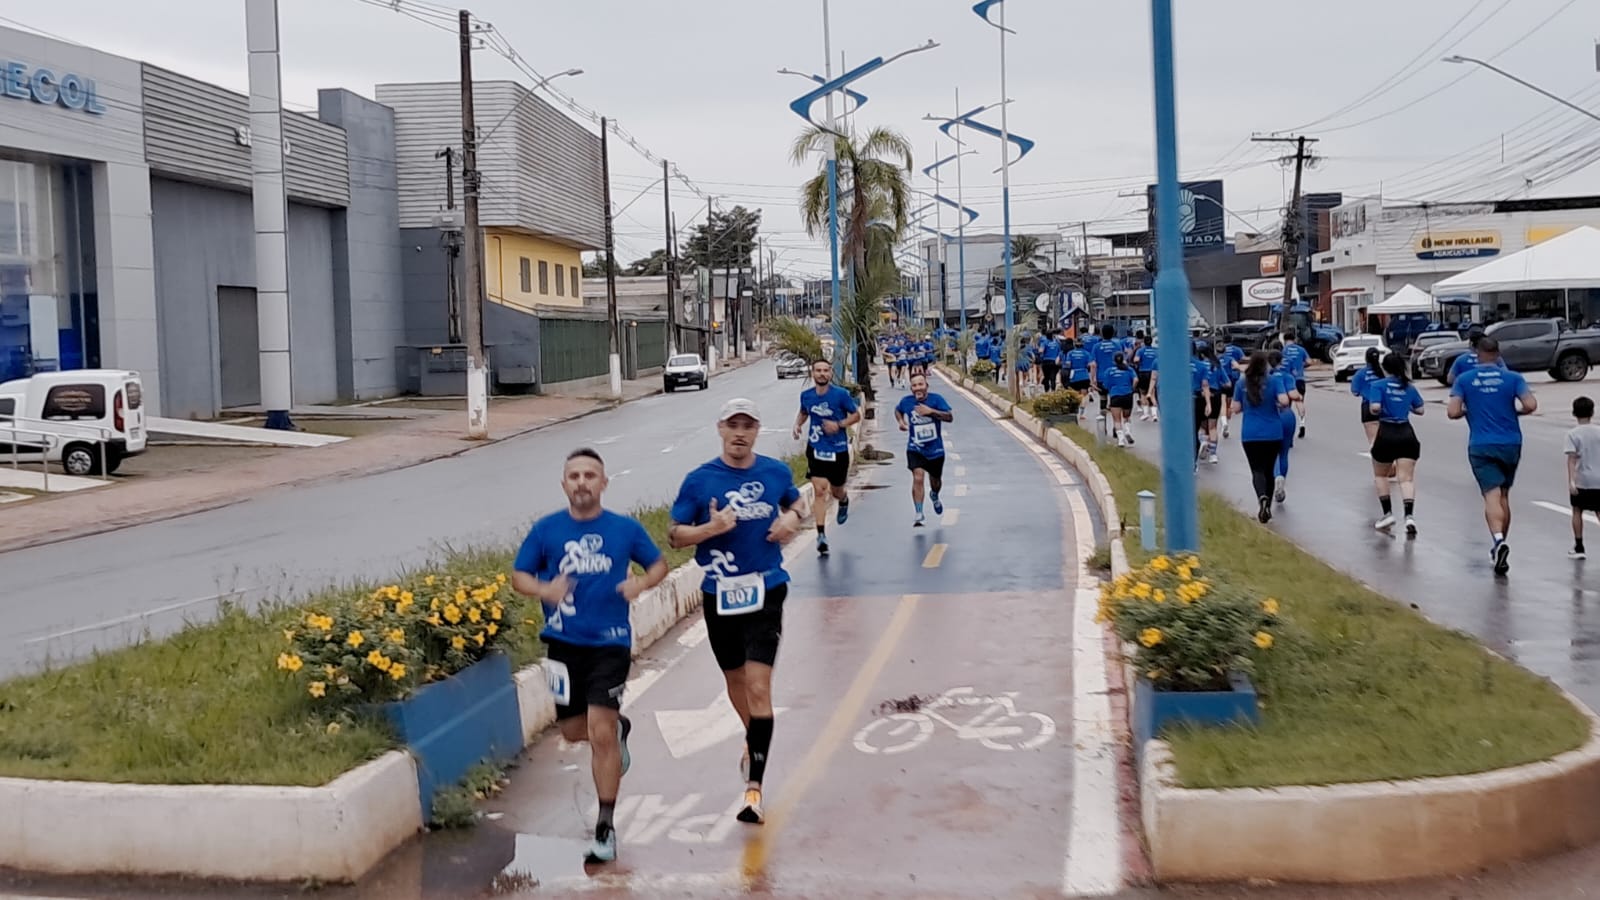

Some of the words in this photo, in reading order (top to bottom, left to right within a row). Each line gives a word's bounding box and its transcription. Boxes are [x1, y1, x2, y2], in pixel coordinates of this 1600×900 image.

[0, 60, 107, 114] ECOL
[1433, 239, 1453, 247] NEW
[1455, 237, 1494, 246] HOLLAND
[1433, 248, 1479, 257] AGRICULTURE
[726, 587, 754, 604] 807
